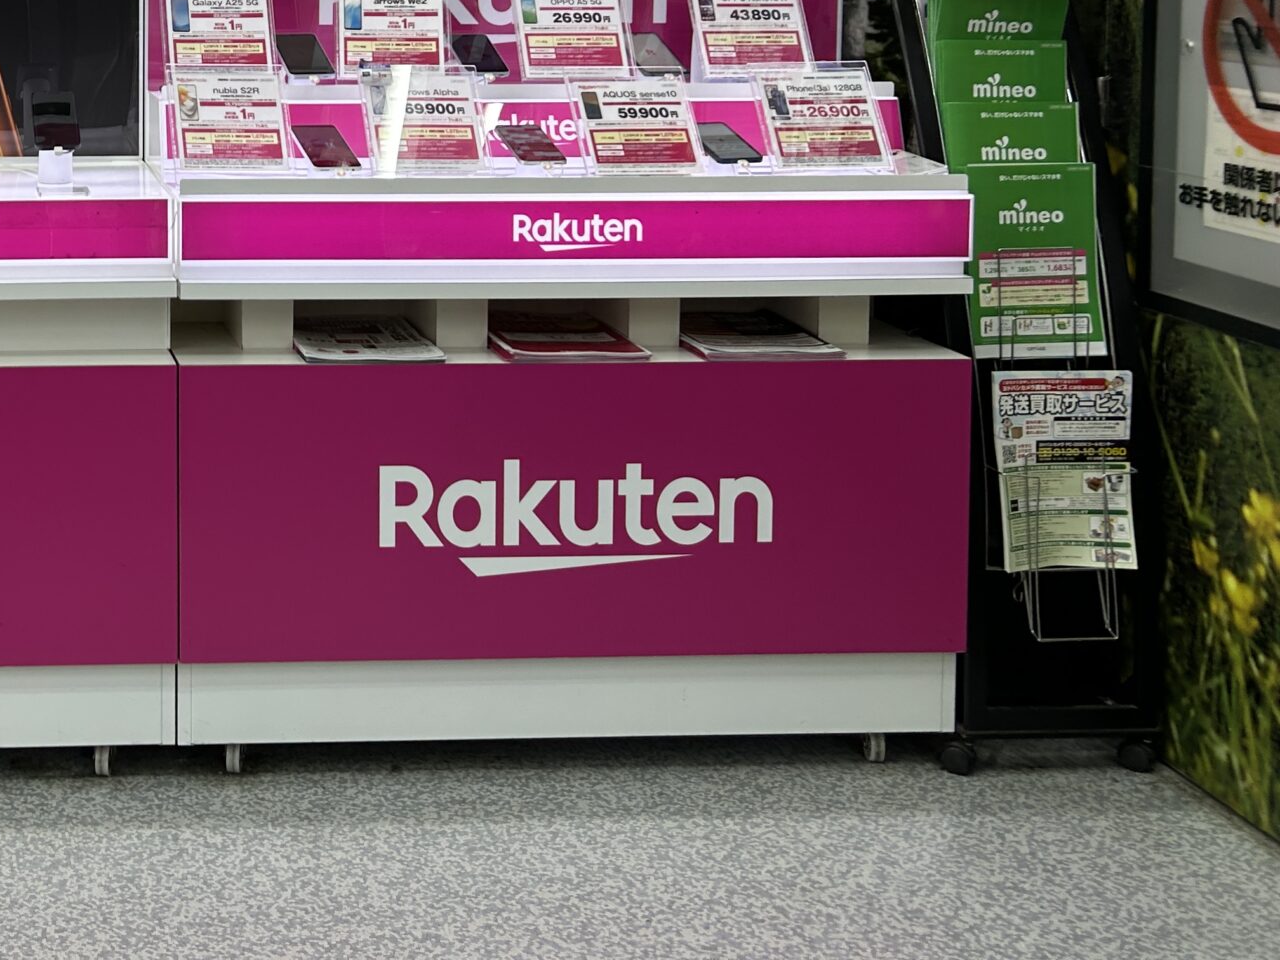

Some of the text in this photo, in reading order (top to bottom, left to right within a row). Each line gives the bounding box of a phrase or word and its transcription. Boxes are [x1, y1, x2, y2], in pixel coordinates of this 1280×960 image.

[192, 0, 222, 7] Galaxy
[730, 9, 790, 21] 43,890円
[552, 12, 611, 24] 26,990円
[967, 10, 1033, 33] mineo
[639, 90, 677, 98] sense10
[973, 74, 1036, 97] mineo
[618, 107, 679, 119] 59,900円
[807, 106, 869, 118] 26,900円
[981, 136, 1047, 160] mineo
[998, 199, 1064, 224] mineo
[511, 214, 644, 245] Rakuten
[999, 393, 1128, 417] 発送買取サービス
[377, 459, 773, 550] Rakuten
